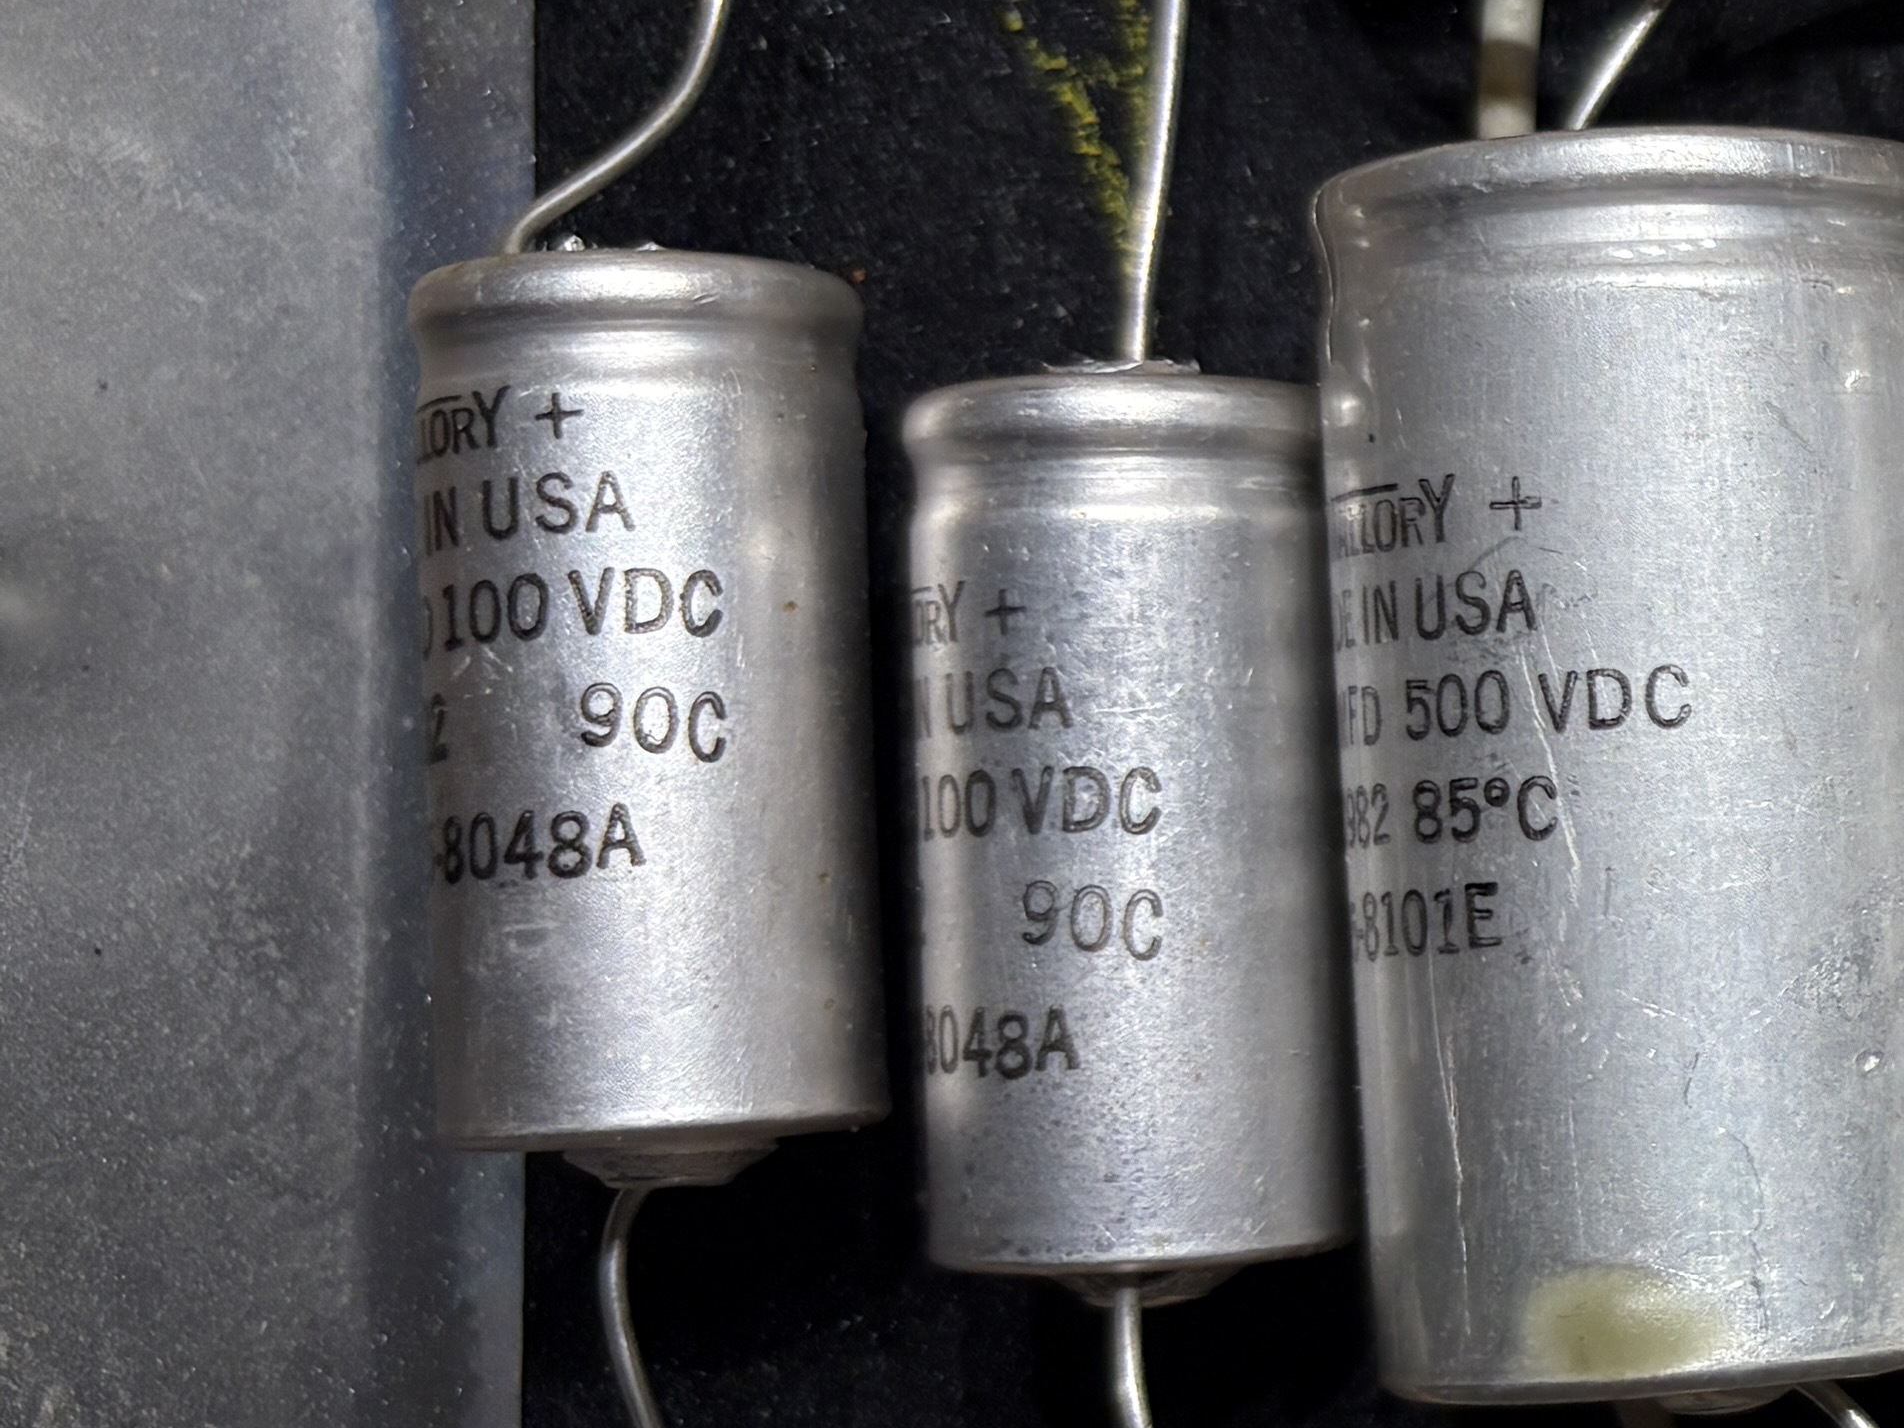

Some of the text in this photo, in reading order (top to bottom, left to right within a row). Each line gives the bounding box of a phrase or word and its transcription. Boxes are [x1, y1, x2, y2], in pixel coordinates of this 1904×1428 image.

[482, 471, 636, 541] USA
[442, 572, 549, 651] 100
[568, 567, 723, 638] VDC
[1362, 580, 1399, 645] IN
[1415, 569, 1537, 641] USA
[580, 682, 727, 763] 90C
[946, 666, 1074, 735] USA
[1405, 670, 1511, 741] 500
[1537, 664, 1692, 733] VDC
[1011, 764, 1163, 835] VDC
[1412, 775, 1558, 844] 85°C
[1022, 879, 1164, 961] 90C
